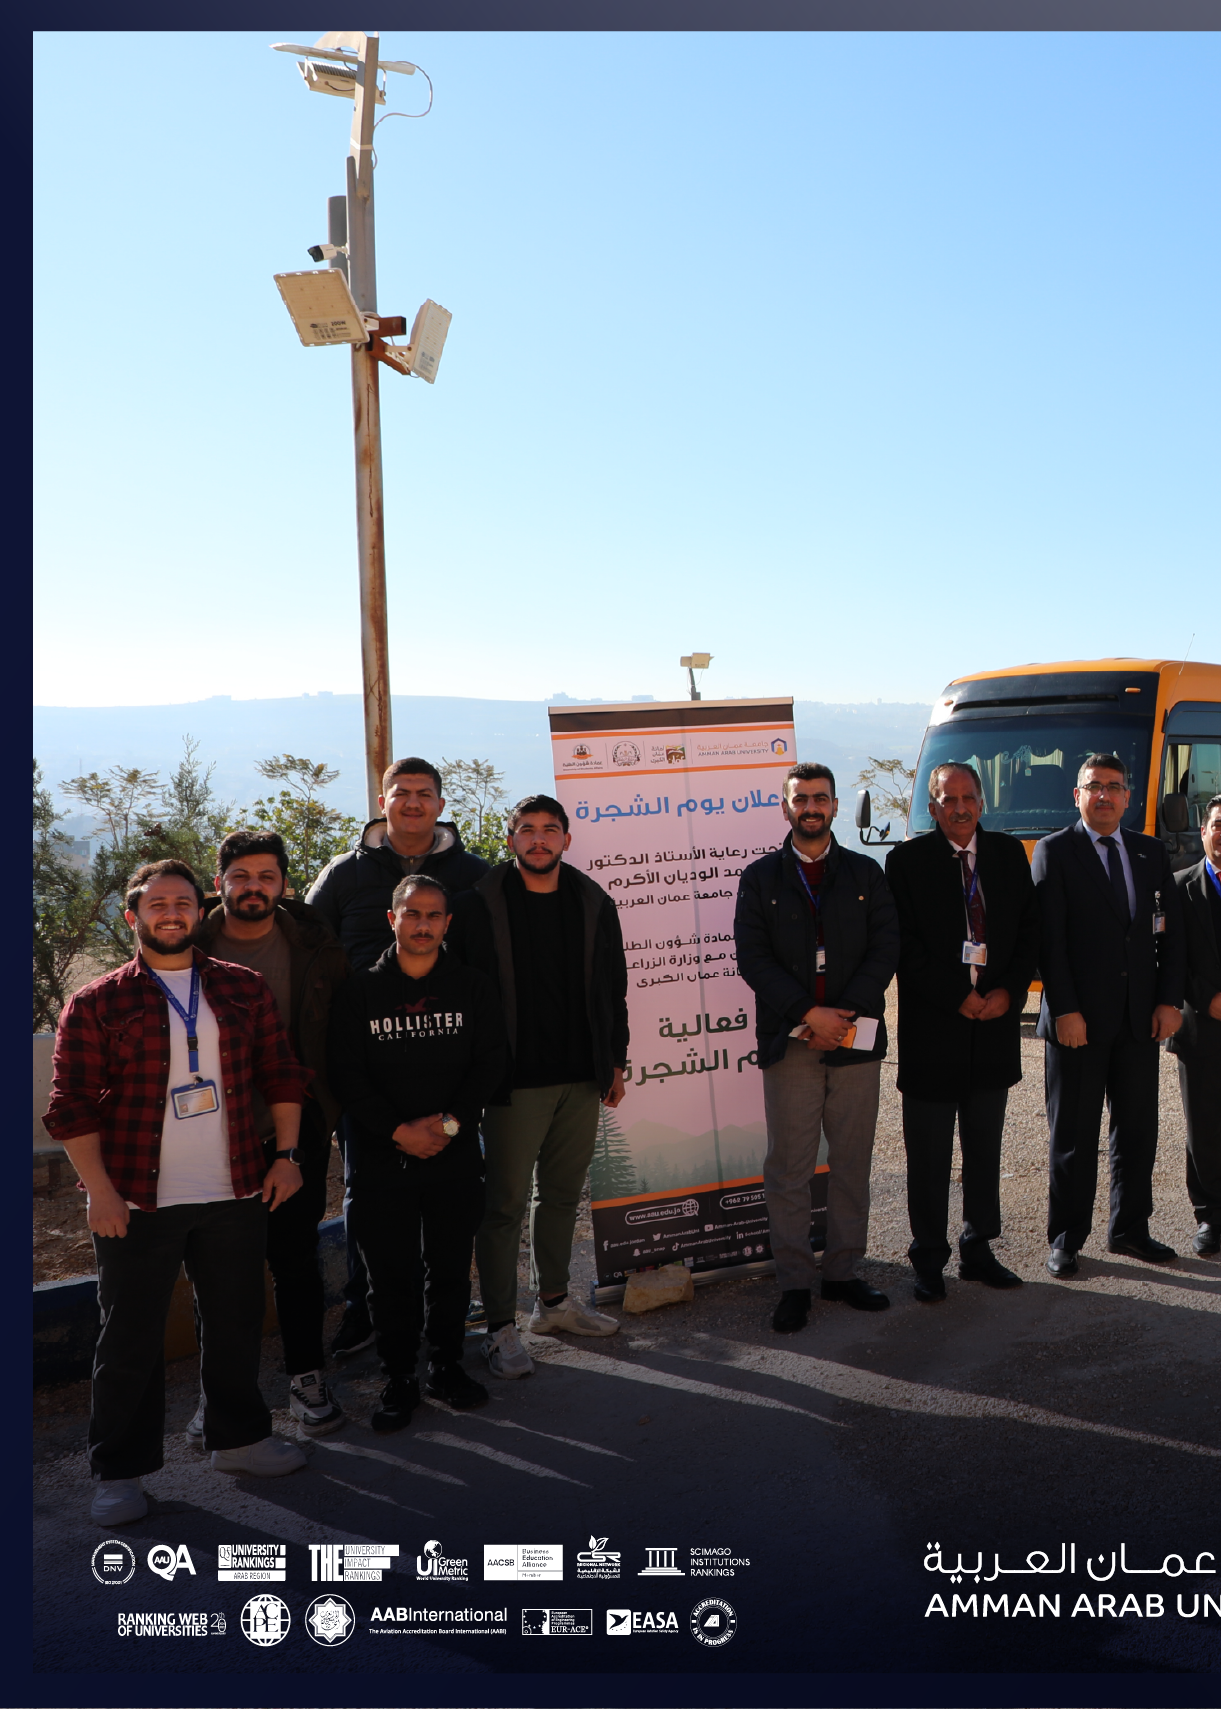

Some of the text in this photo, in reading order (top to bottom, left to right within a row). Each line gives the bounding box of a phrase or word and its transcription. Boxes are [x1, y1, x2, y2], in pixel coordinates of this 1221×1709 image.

[575, 789, 781, 823] علان يوم الشجرة
[654, 846, 706, 863] الأستاذ
[710, 847, 748, 861] رعاية
[586, 853, 649, 871] الدكتور
[608, 869, 660, 890] الأكرم
[664, 866, 719, 886] الوديان
[657, 894, 691, 905] عمان
[694, 889, 733, 900] جامعة
[614, 895, 654, 910] العربي
[655, 933, 701, 950] شؤون
[703, 932, 735, 944] مادة
[626, 956, 666, 970] الزراع
[669, 954, 700, 967] وزارة
[636, 973, 684, 988] الكبرى
[687, 971, 720, 982] عمان
[369, 1012, 463, 1035] HOLLISTER
[659, 1007, 748, 1043] فعالية
[378, 1028, 459, 1041] CALIFORNIA
[628, 1207, 681, 1221] www.aau.edu.jo
